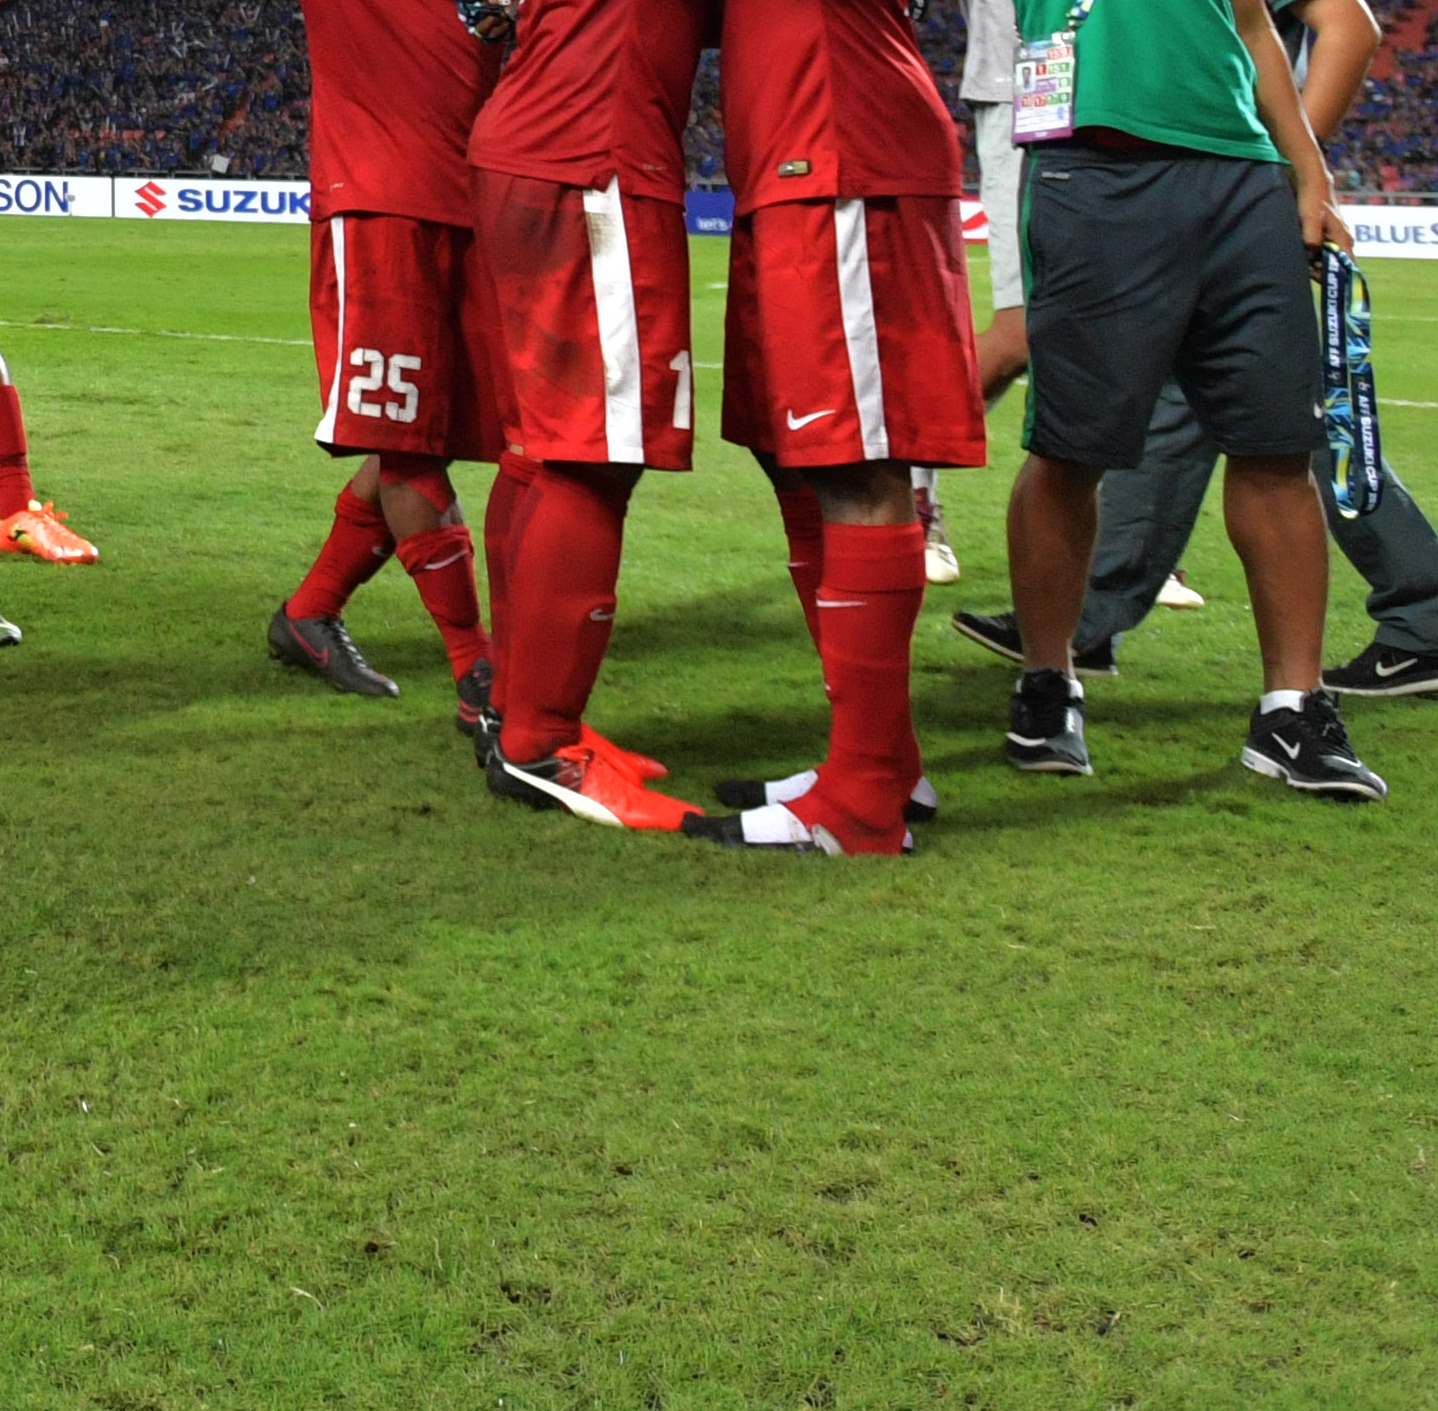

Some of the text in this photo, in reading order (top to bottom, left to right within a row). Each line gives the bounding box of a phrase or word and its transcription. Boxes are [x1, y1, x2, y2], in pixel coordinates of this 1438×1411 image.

[1327, 272, 1340, 299] CUP
[1327, 300, 1340, 347] SUZUKI
[1328, 346, 1341, 369] AFF
[347, 347, 422, 423] 25
[1358, 395, 1371, 417] AFF
[1360, 416, 1376, 467] SUZUKI
[1366, 466, 1380, 492] CUP
